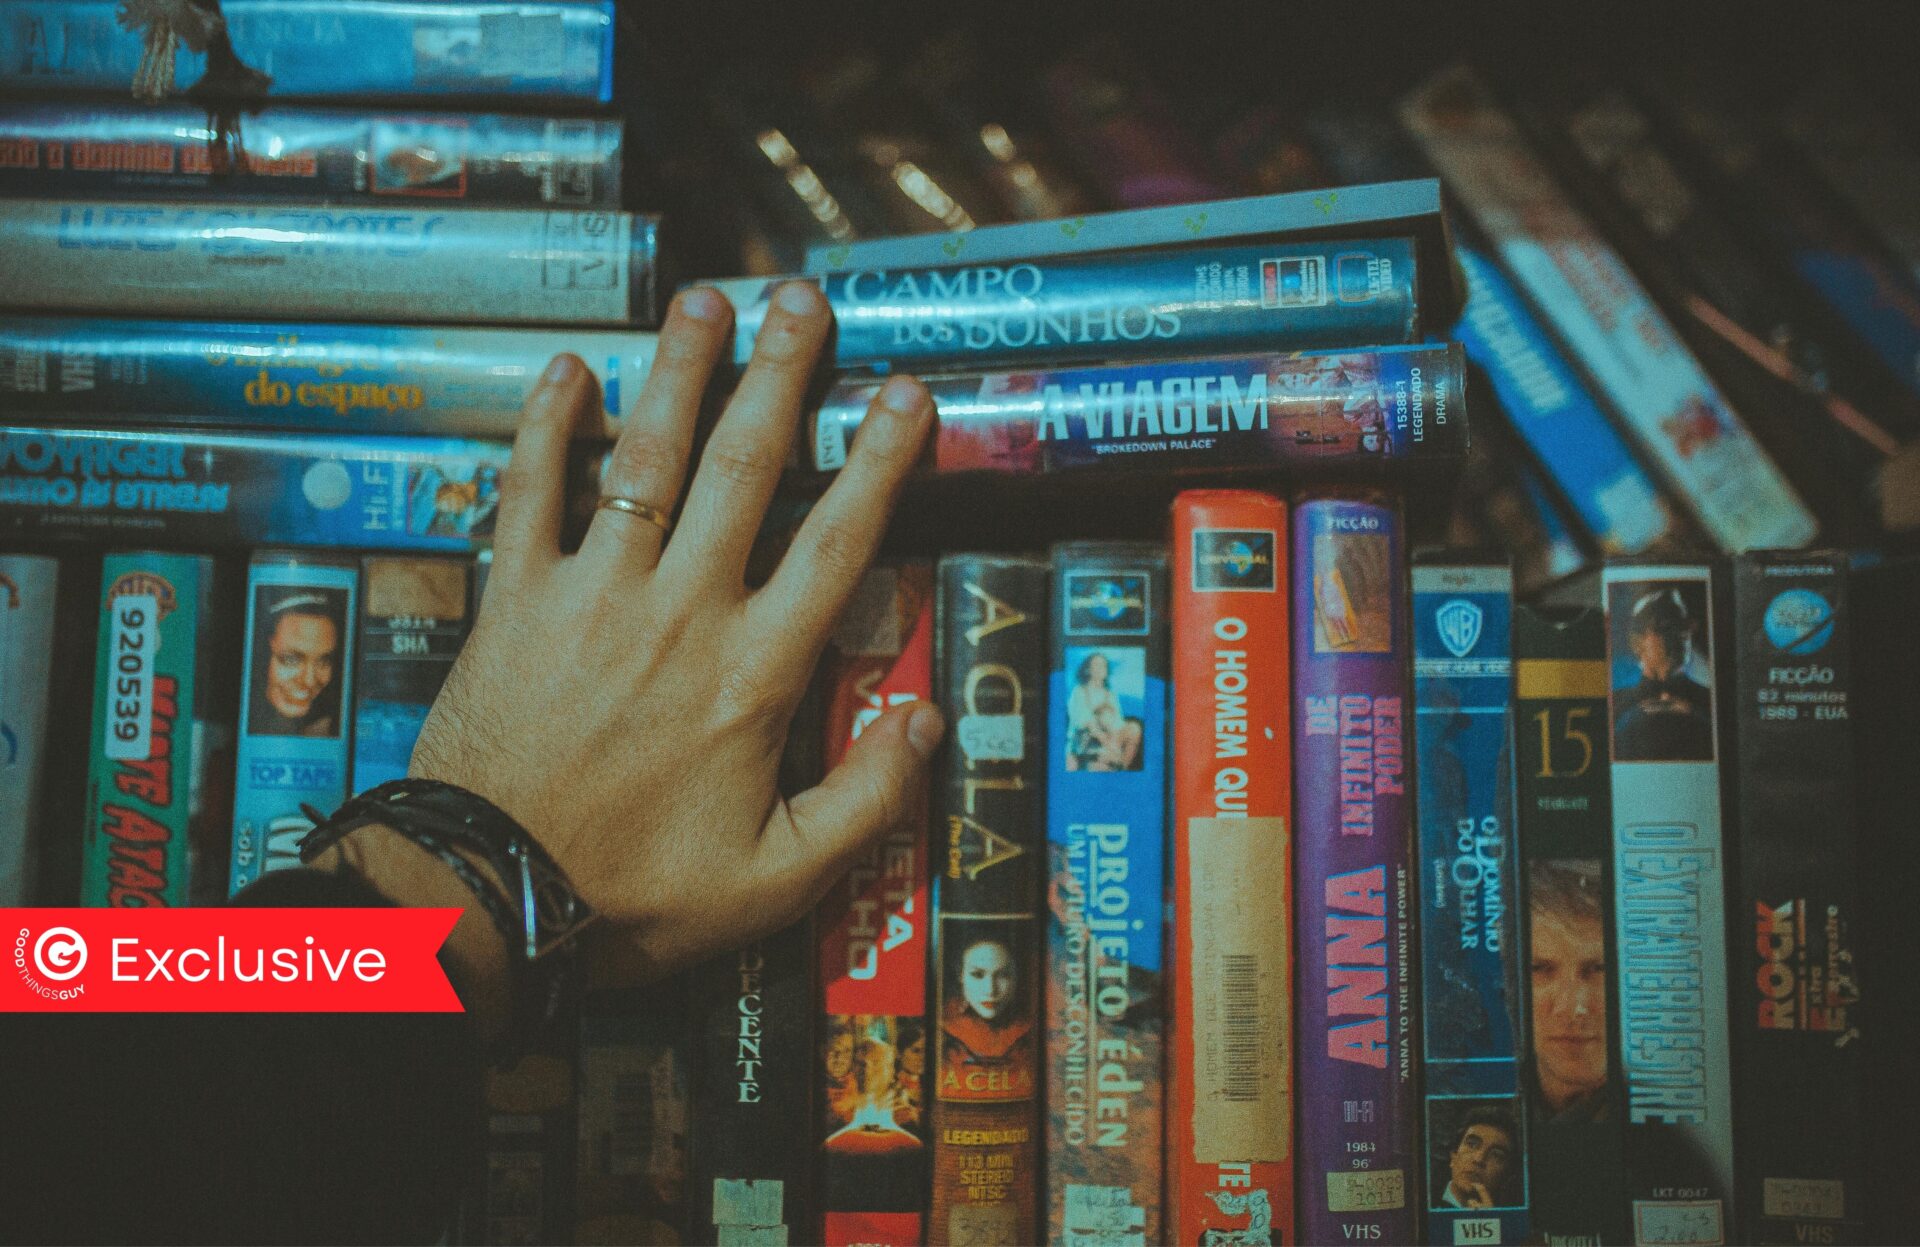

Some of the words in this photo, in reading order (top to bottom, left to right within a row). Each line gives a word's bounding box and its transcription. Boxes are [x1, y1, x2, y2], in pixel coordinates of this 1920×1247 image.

[844, 263, 1043, 306] CAMPO
[965, 304, 1182, 351] SONHOS
[244, 368, 292, 407] do
[1037, 381, 1069, 443] A
[1080, 374, 1268, 440] VIAGEM
[1410, 367, 1424, 442] LEGENDADO
[1434, 382, 1447, 425] DRAMA
[1214, 616, 1249, 642] O
[113, 609, 146, 742] 920539
[1214, 650, 1249, 759] HOMEM
[1532, 706, 1594, 779] 15
[1451, 853, 1484, 950] OLHAR
[1324, 863, 1390, 1069] ANNA
[1398, 923, 1408, 983] INFINITE
[1755, 899, 1795, 1029] ROCK
[1399, 986, 1408, 1014] THE
[1399, 1016, 1409, 1035] TO
[1341, 1223, 1382, 1241] VHS
[1461, 1222, 1493, 1240] VHS
